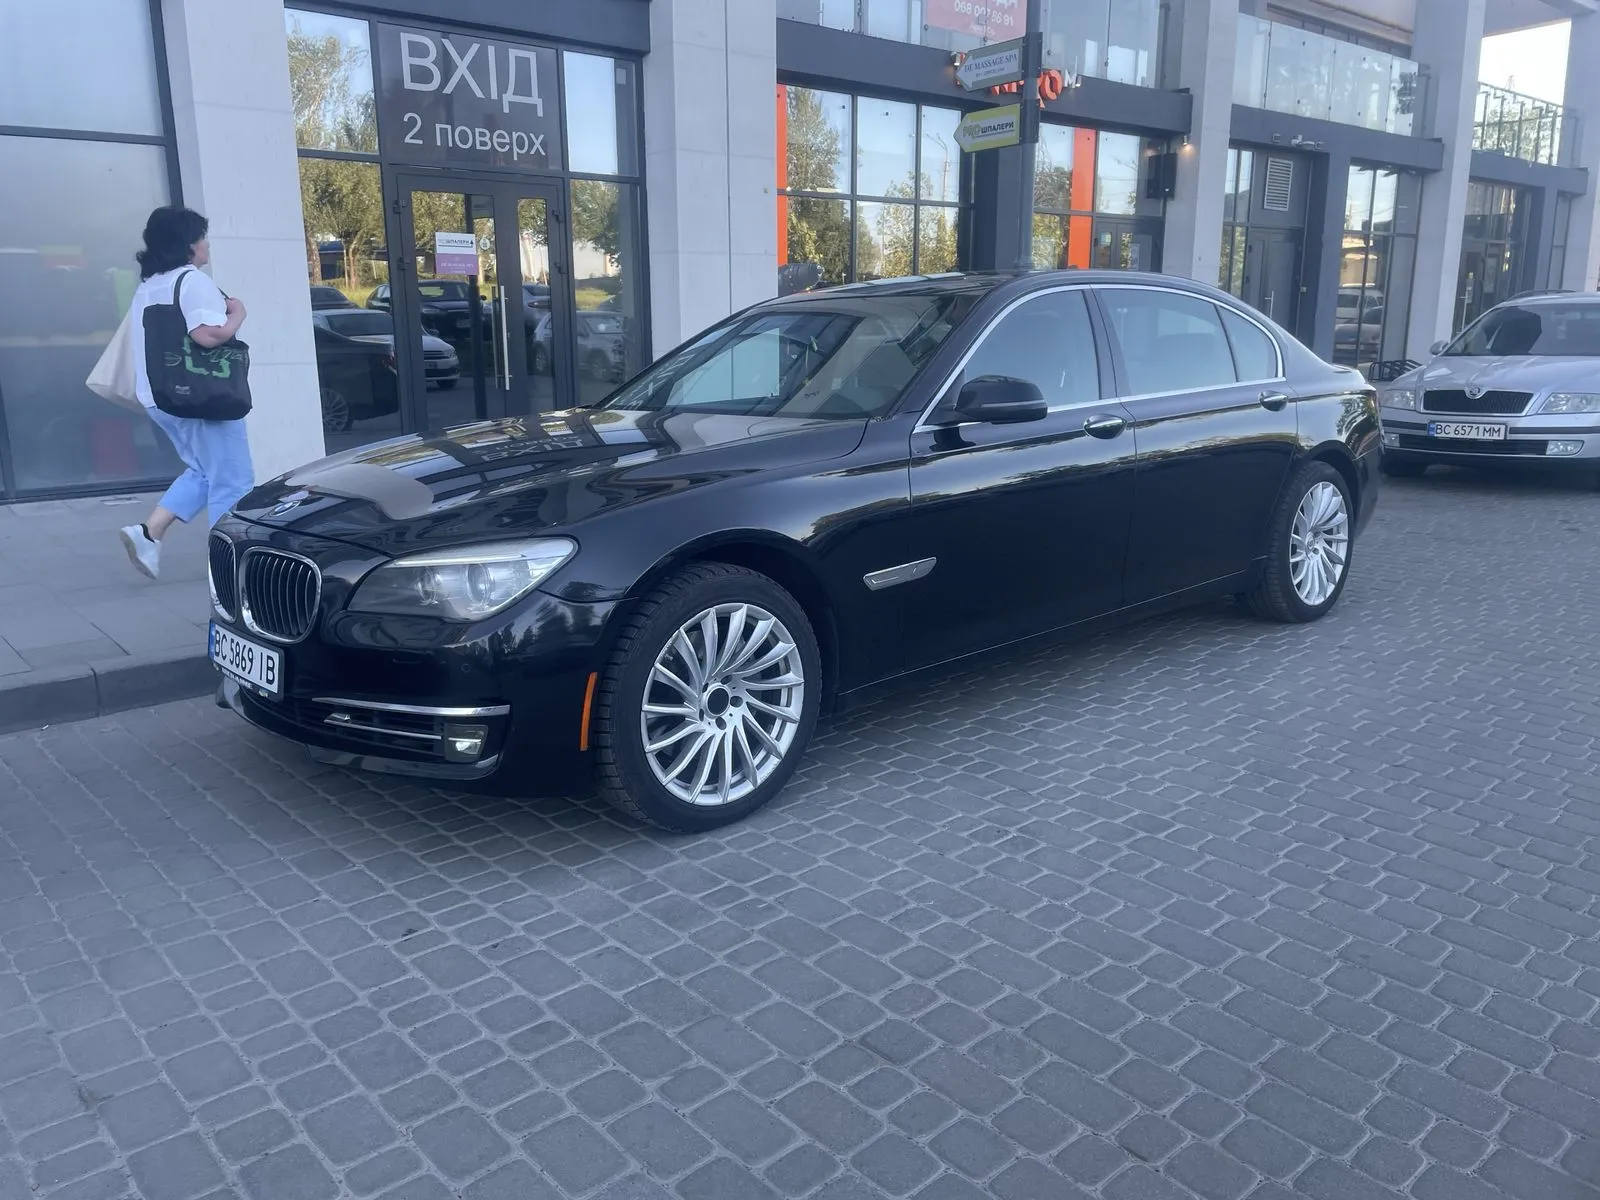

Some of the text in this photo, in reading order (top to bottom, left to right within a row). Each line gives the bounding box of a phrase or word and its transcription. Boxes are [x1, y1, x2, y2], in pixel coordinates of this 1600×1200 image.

[954, 0, 972, 14] 068
[1003, 15, 1014, 26] 91
[400, 32, 544, 117] ВХІД
[975, 56, 1004, 69] MASSAGE
[1005, 53, 1017, 63] SPA
[403, 113, 546, 160] 2 поверх
[1435, 424, 1501, 437] BC 6571 MM
[214, 629, 228, 661] BC
[229, 638, 254, 674] 5869
[260, 652, 275, 685] IB
